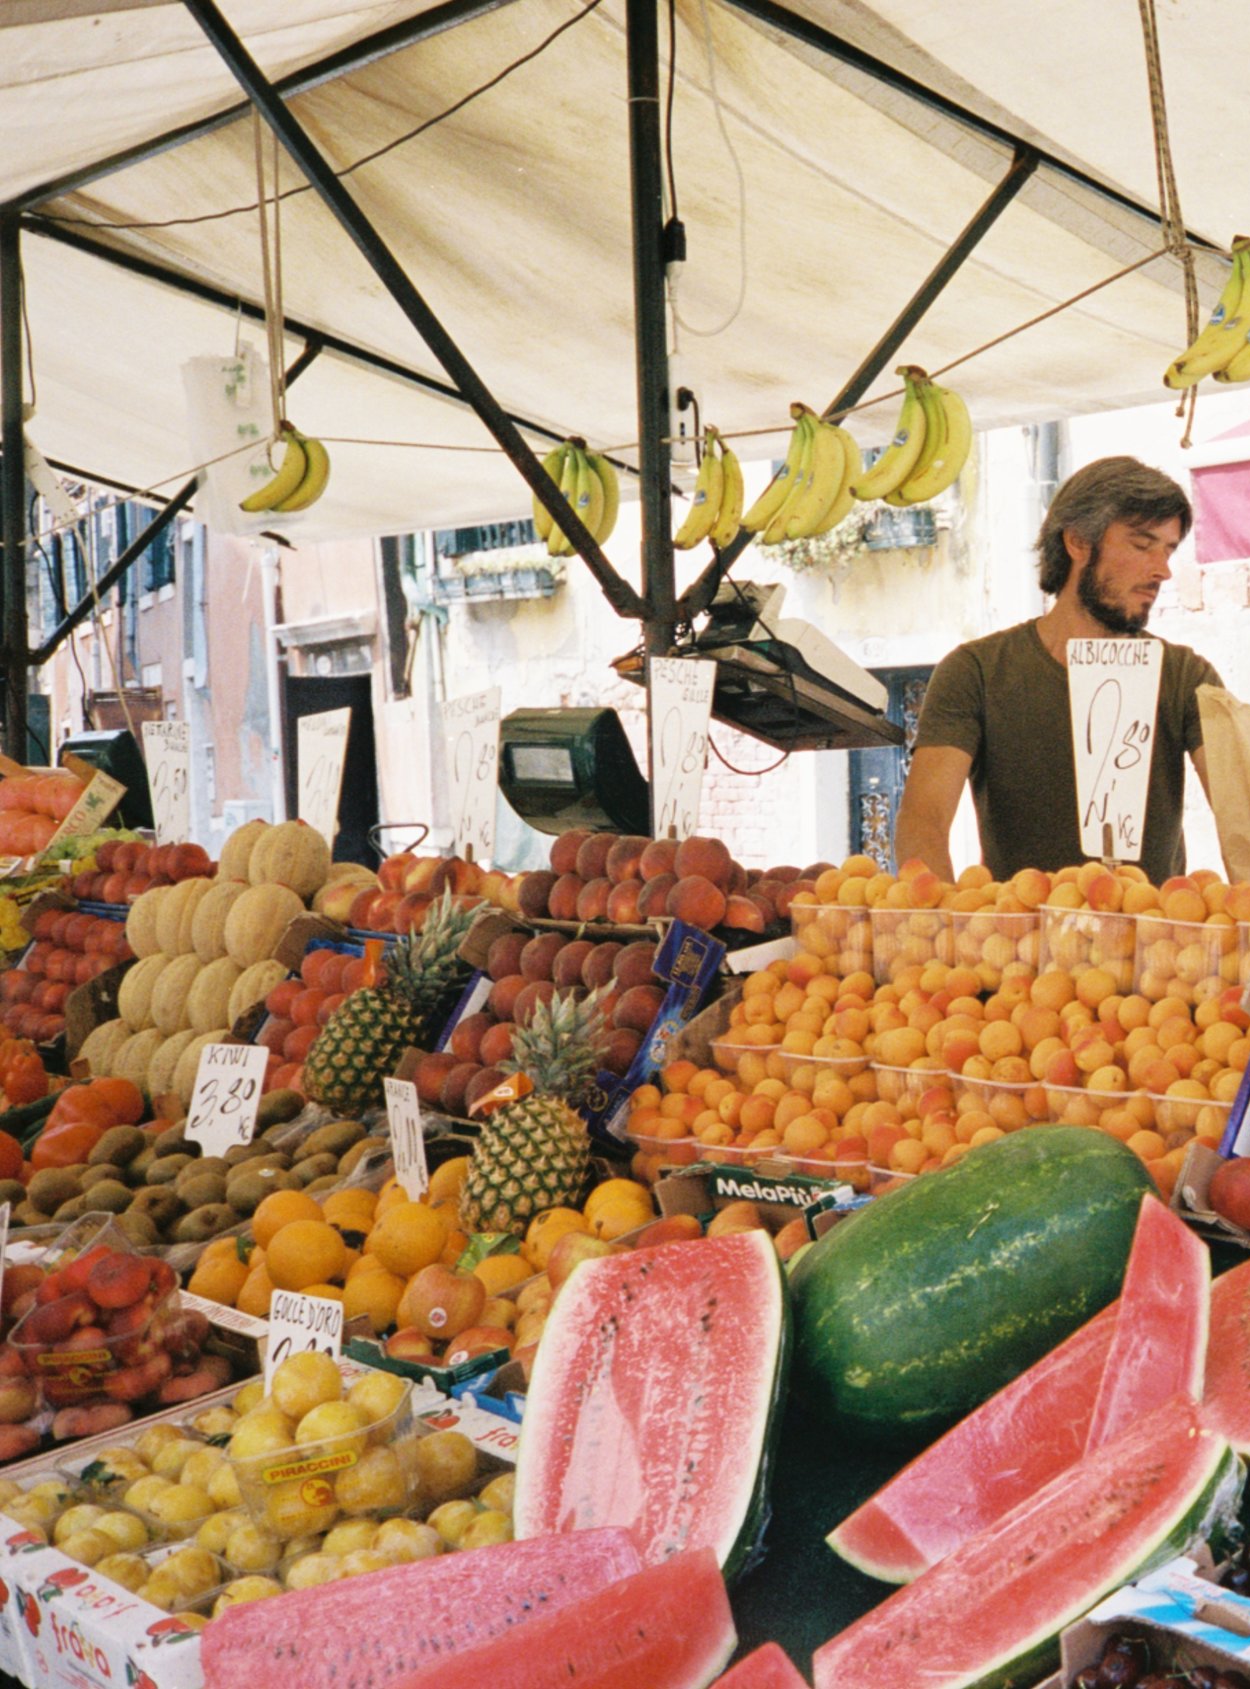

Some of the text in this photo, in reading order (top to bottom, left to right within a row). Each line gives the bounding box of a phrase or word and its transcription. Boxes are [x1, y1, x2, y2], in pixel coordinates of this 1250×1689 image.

[1069, 640, 1152, 667] ALBICOCCHE
[207, 1045, 251, 1068] KIWI
[269, 1454, 352, 1481] PIRACCINI
